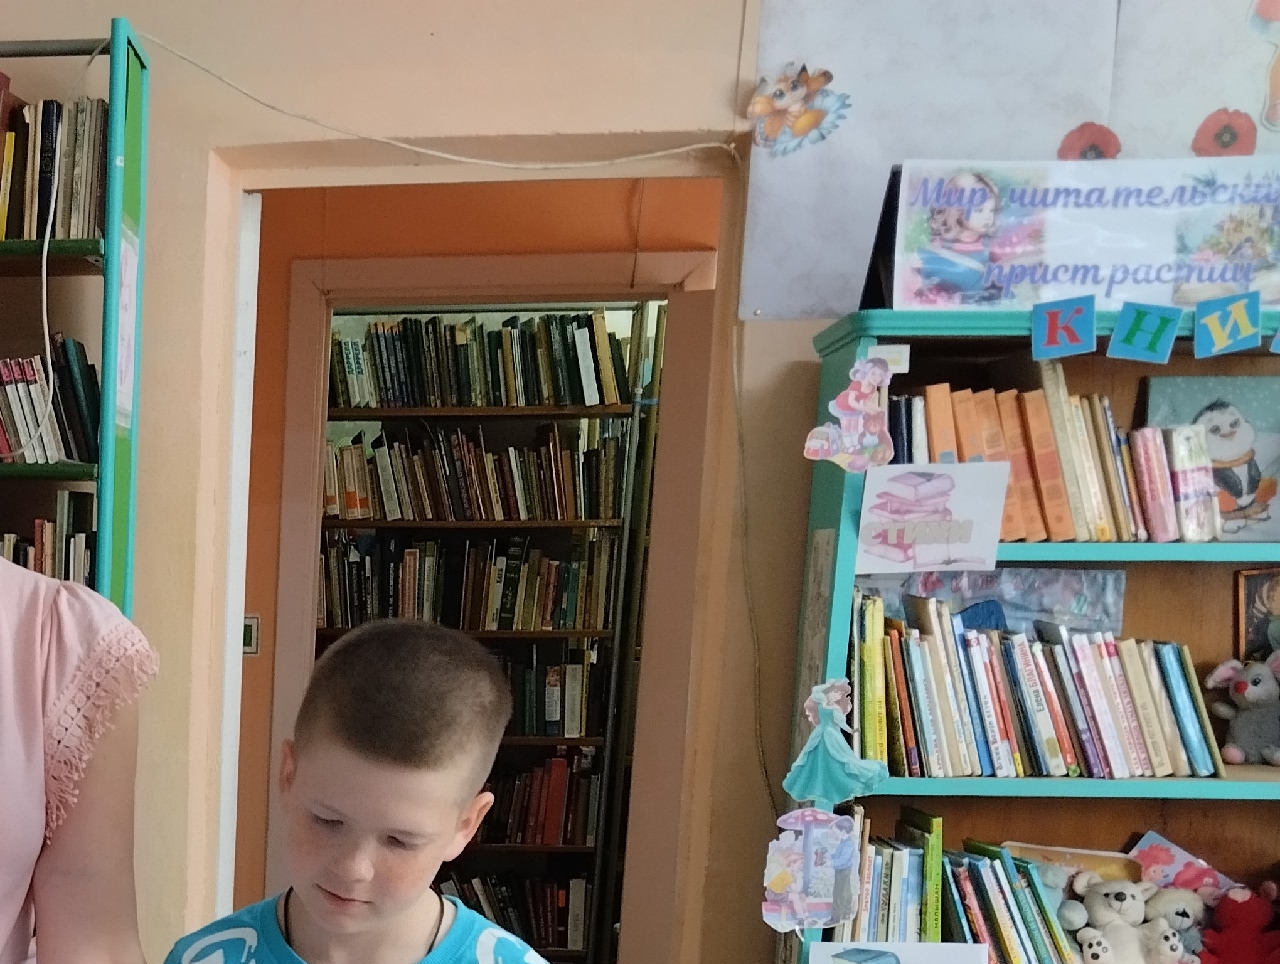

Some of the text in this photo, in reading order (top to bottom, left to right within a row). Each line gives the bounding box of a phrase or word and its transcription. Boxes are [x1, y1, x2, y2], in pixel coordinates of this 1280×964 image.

[909, 177, 1280, 219] Мир читательски
[860, 519, 974, 546] СТИХИ
[1017, 640, 1039, 689] БЛАГИНИНА
[932, 883, 941, 929] МАЛЫШАМ
